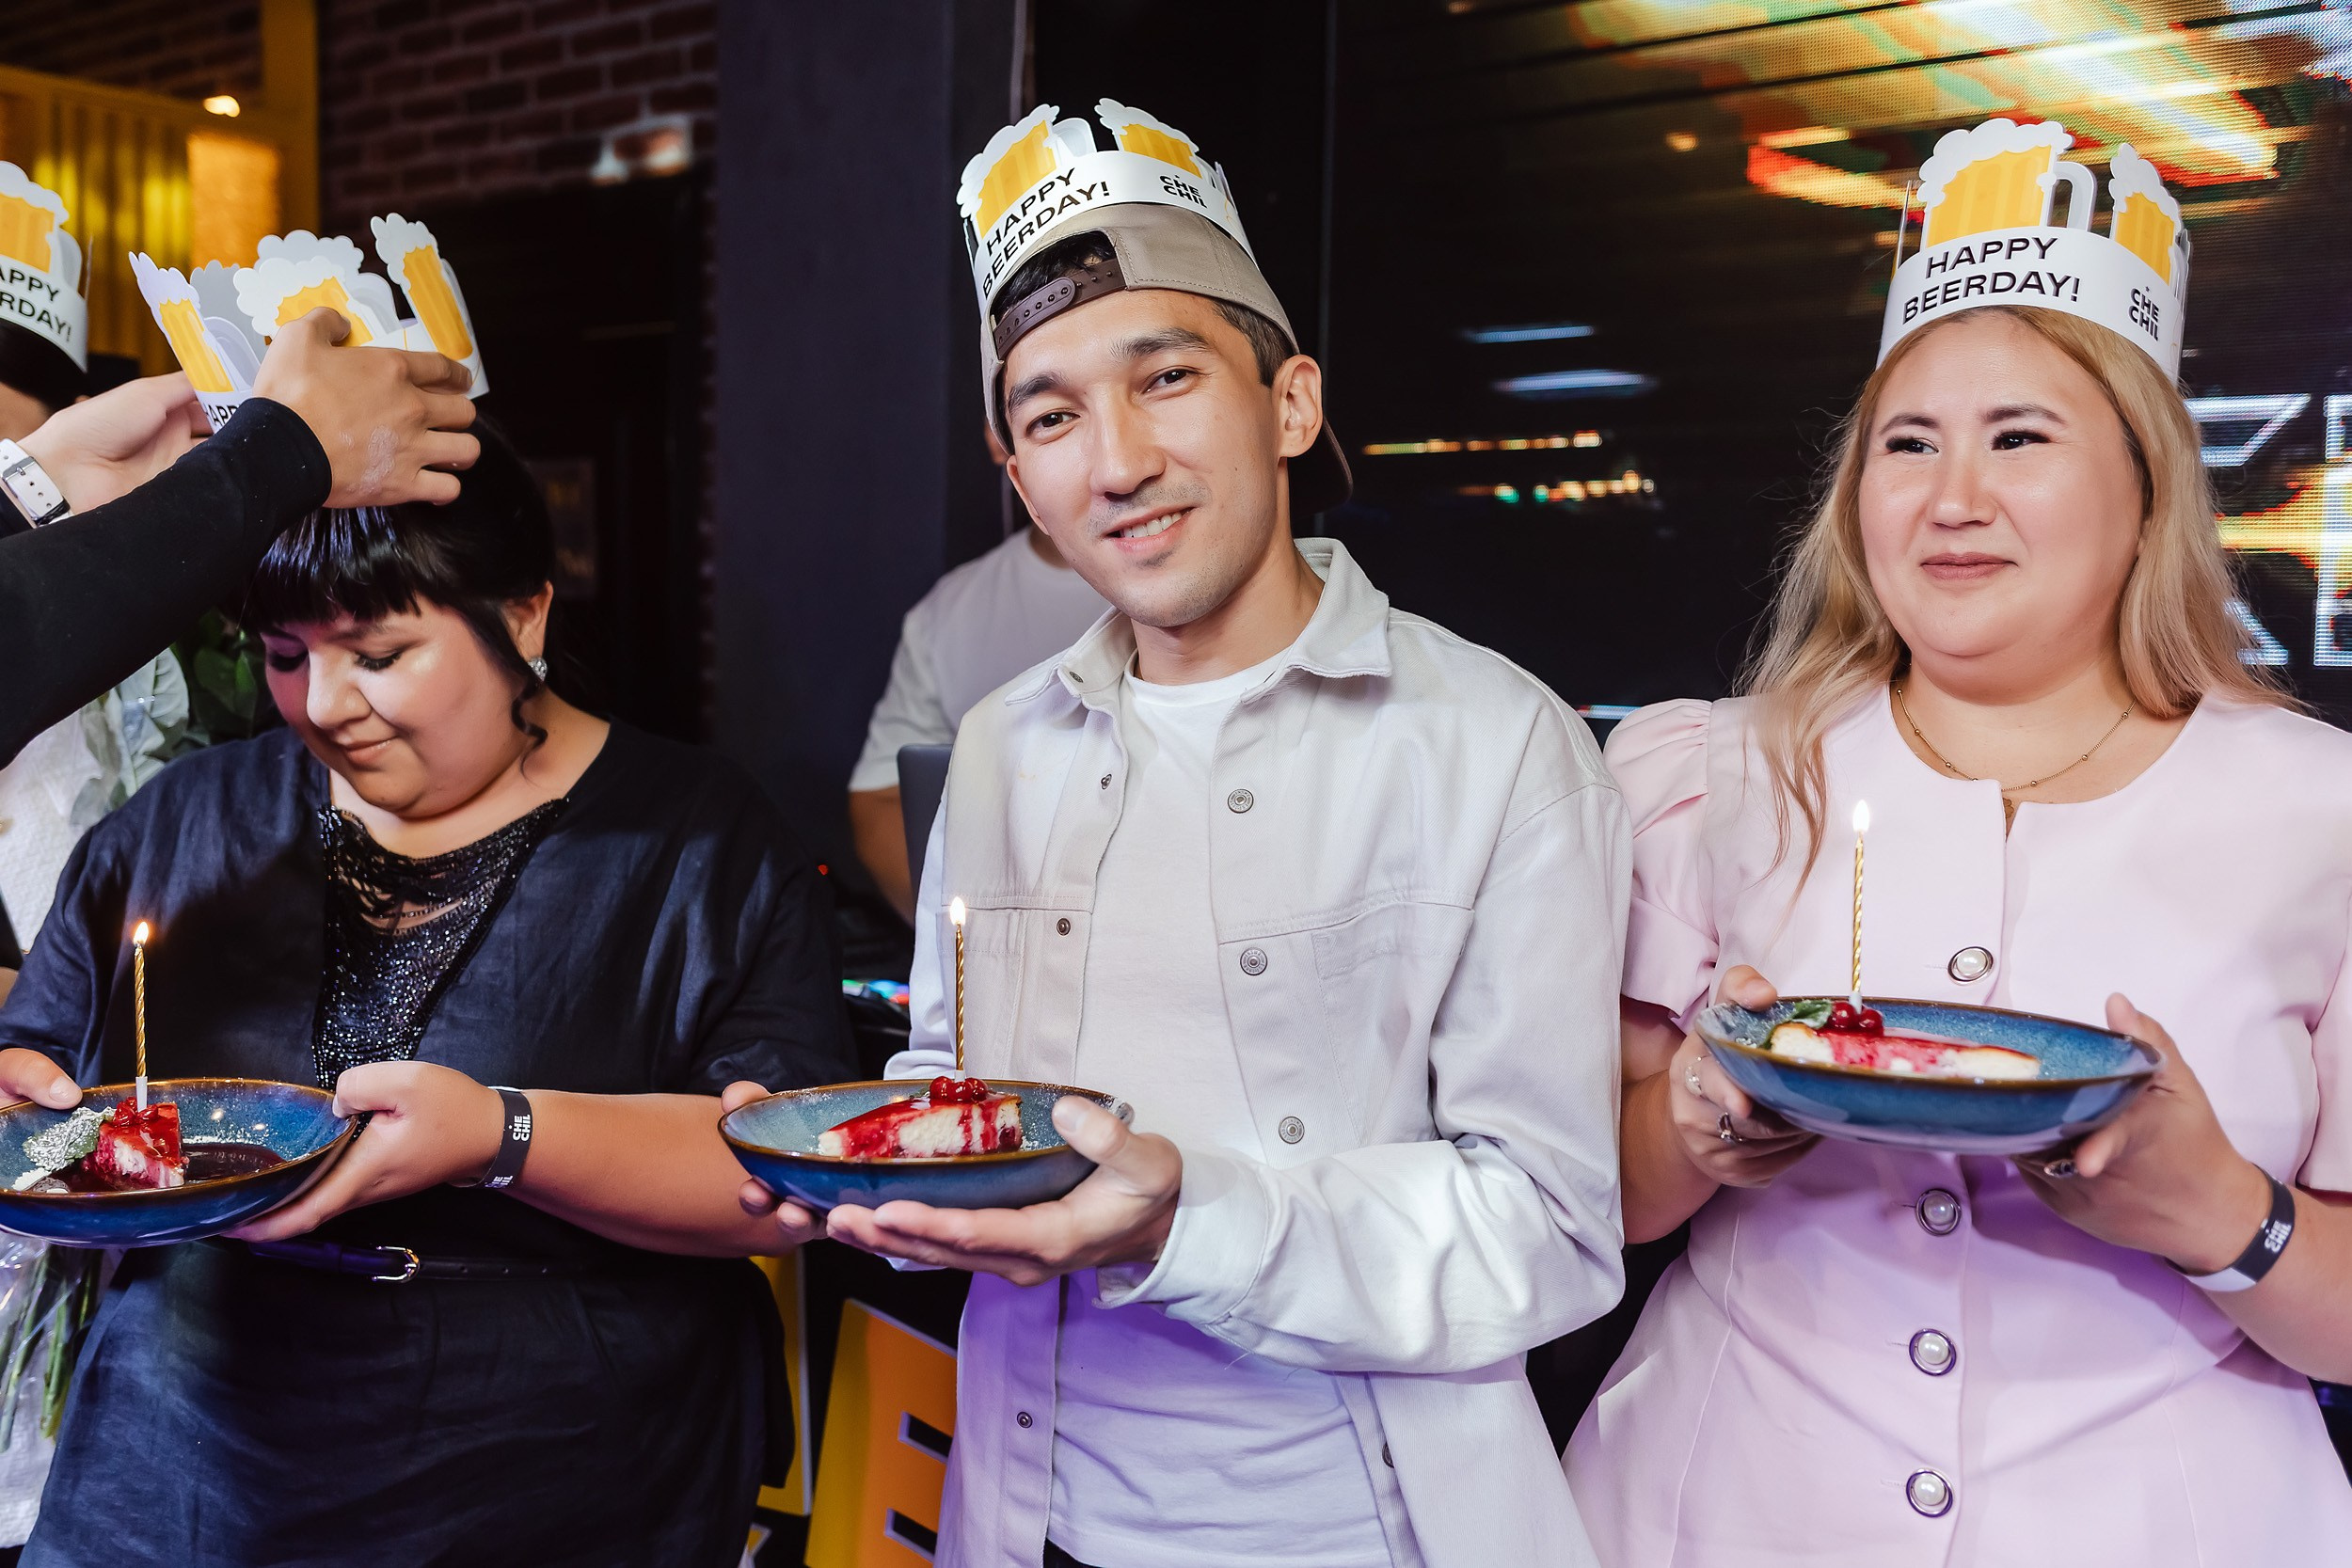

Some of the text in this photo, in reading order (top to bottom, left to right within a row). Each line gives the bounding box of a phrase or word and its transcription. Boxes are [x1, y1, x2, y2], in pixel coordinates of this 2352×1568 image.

[1159, 176, 1201, 198] CHE
[1163, 185, 1208, 209] CHIL
[986, 167, 1075, 257] HAPPY
[982, 181, 1110, 300] BEERDAY!
[1926, 237, 2058, 278] HAPPY
[1902, 271, 2080, 325] BEERDAY!
[2130, 288, 2159, 323] CHE
[2128, 305, 2158, 341] CHIL
[513, 1115, 523, 1141] CHE
[521, 1114, 531, 1142] CHIL
